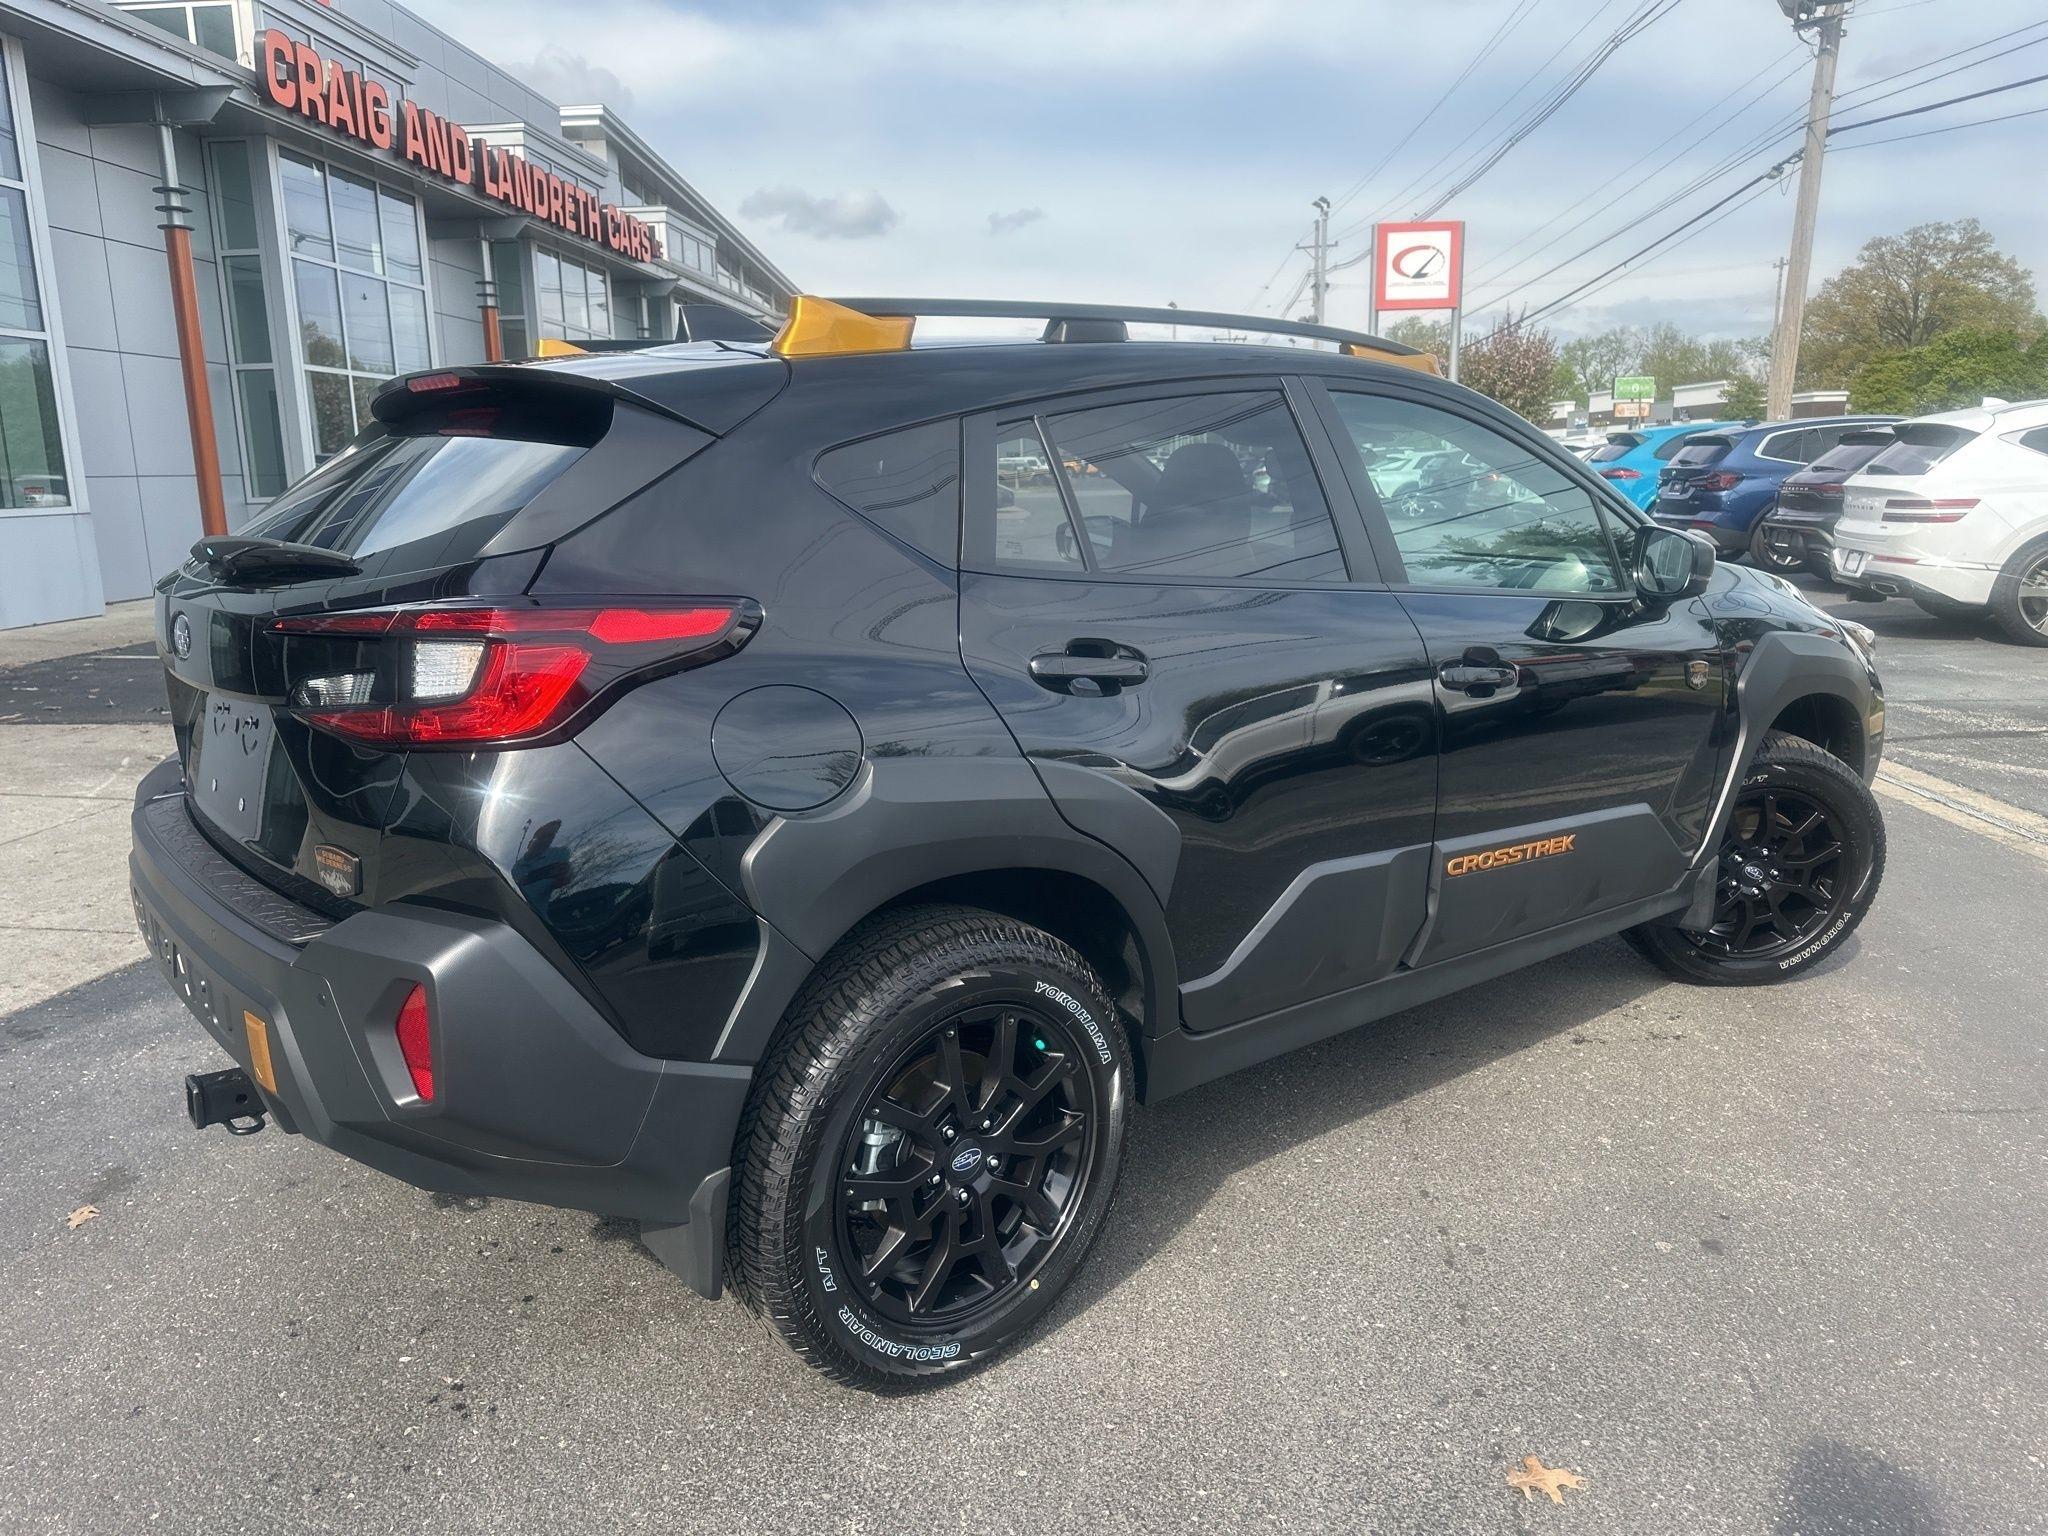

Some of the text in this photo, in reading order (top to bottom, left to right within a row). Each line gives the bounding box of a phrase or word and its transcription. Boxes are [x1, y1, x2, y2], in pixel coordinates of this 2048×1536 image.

[263, 27, 652, 264] CRAIG AND LANDRETH CARS
[1446, 834, 1577, 876] CROSSTREK
[1779, 912, 1852, 970] YOKOHAMA
[1034, 981, 1113, 1065] YOKOHAMA
[816, 1245, 961, 1361] GEOLANDAR A/T
